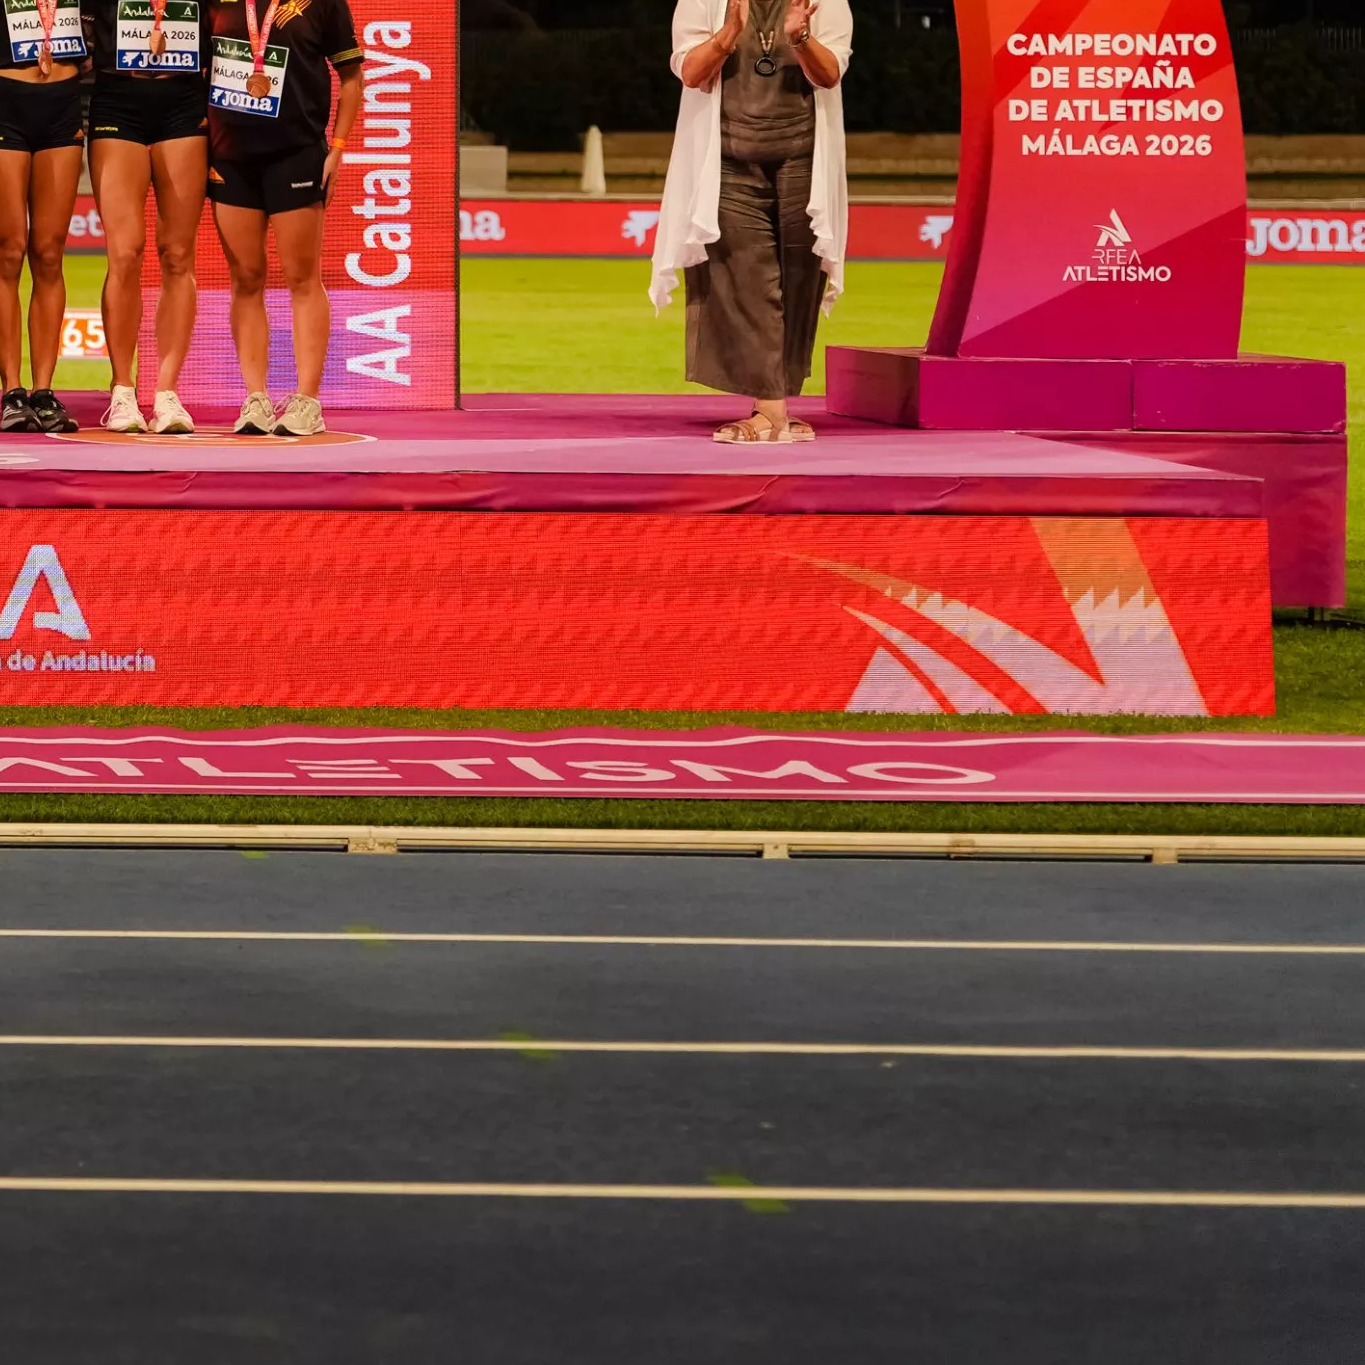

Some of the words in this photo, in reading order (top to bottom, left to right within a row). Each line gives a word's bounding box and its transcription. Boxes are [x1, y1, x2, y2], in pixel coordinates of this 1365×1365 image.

[13, 17, 56, 31] MÁLAA
[59, 17, 79, 27] 2026
[121, 28, 170, 39] MÁLAA
[171, 31, 196, 40] 2026
[1007, 33, 1217, 56] CAMPEONATO
[214, 65, 249, 80] MÁLAGA
[1030, 66, 1070, 89] DE
[1078, 59, 1195, 89] ESPAÑA
[1008, 99, 1048, 122] DE
[1055, 99, 1224, 122] ATLETISMO
[342, 20, 431, 286] Catalunya
[1022, 128, 1139, 156] MÁLAGA
[1145, 134, 1212, 157] 2026
[1062, 265, 1172, 282] ATLETISMO
[346, 305, 412, 386] AA
[6, 649, 36, 672] de
[41, 648, 156, 672] Andalucía
